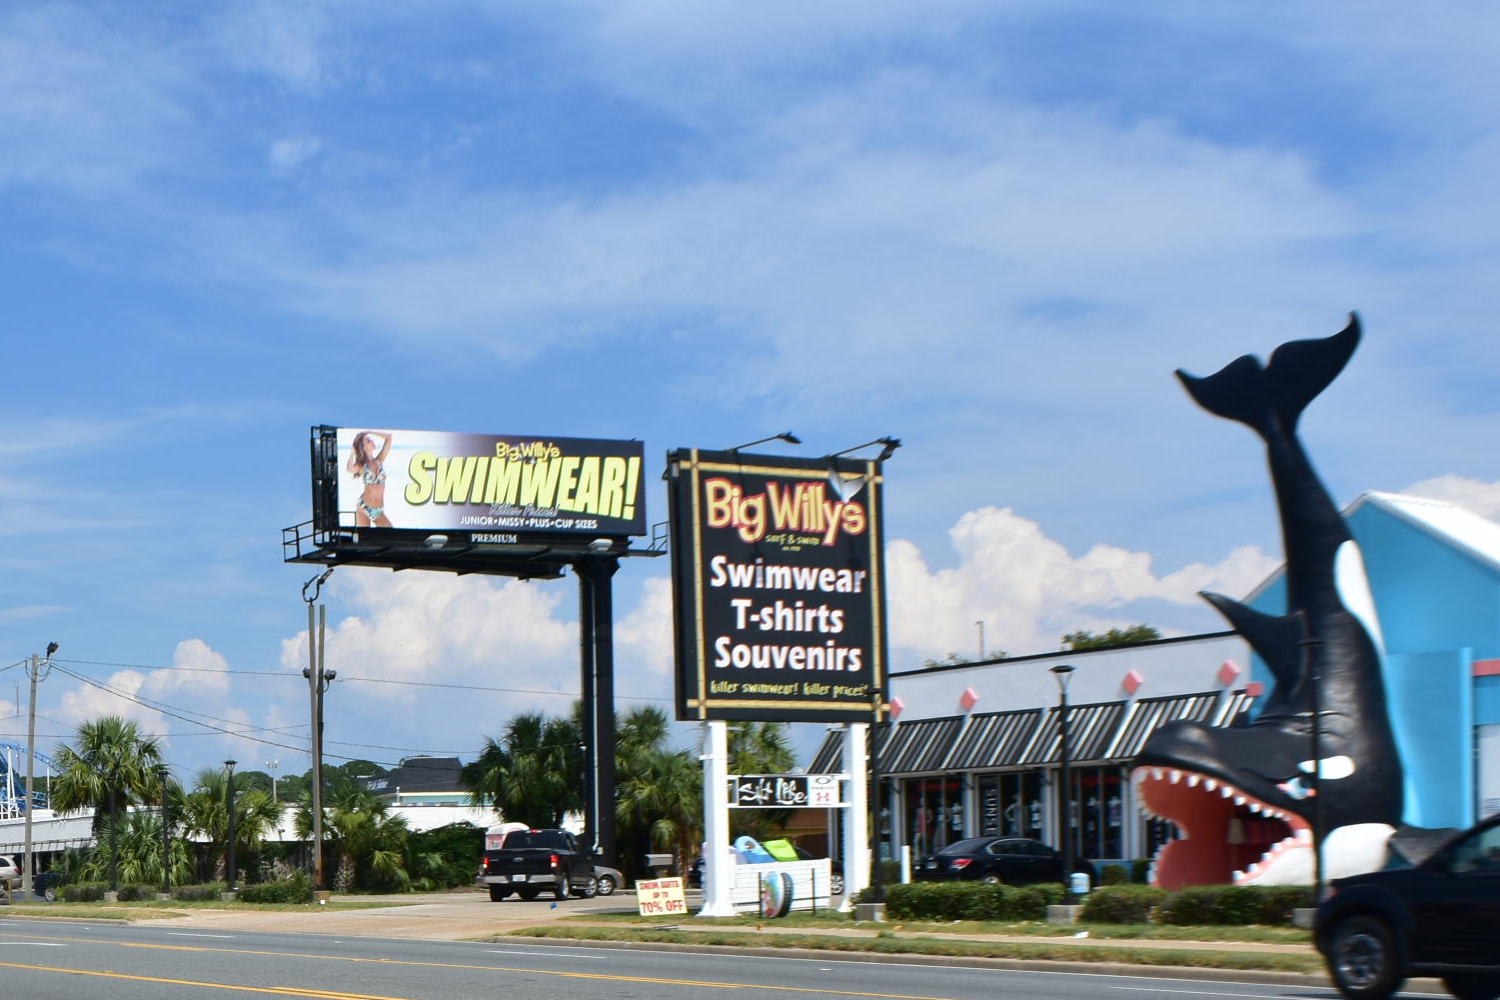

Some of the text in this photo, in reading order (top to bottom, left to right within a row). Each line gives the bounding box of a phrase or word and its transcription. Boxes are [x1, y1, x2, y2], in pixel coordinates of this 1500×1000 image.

[496, 442, 519, 462] Big
[404, 451, 641, 520] SWIMWEAR!
[460, 515, 598, 529] JUNIOR MISSY PLUS CUP SIZES
[705, 477, 766, 543] Big
[471, 533, 517, 544] PREMIUM
[710, 555, 866, 593] Swimwear
[731, 598, 844, 634] T-shirts
[714, 636, 862, 672] Souvenirs
[710, 680, 739, 694] killer
[803, 682, 831, 696] killer
[640, 900, 683, 914] 70% OFF
